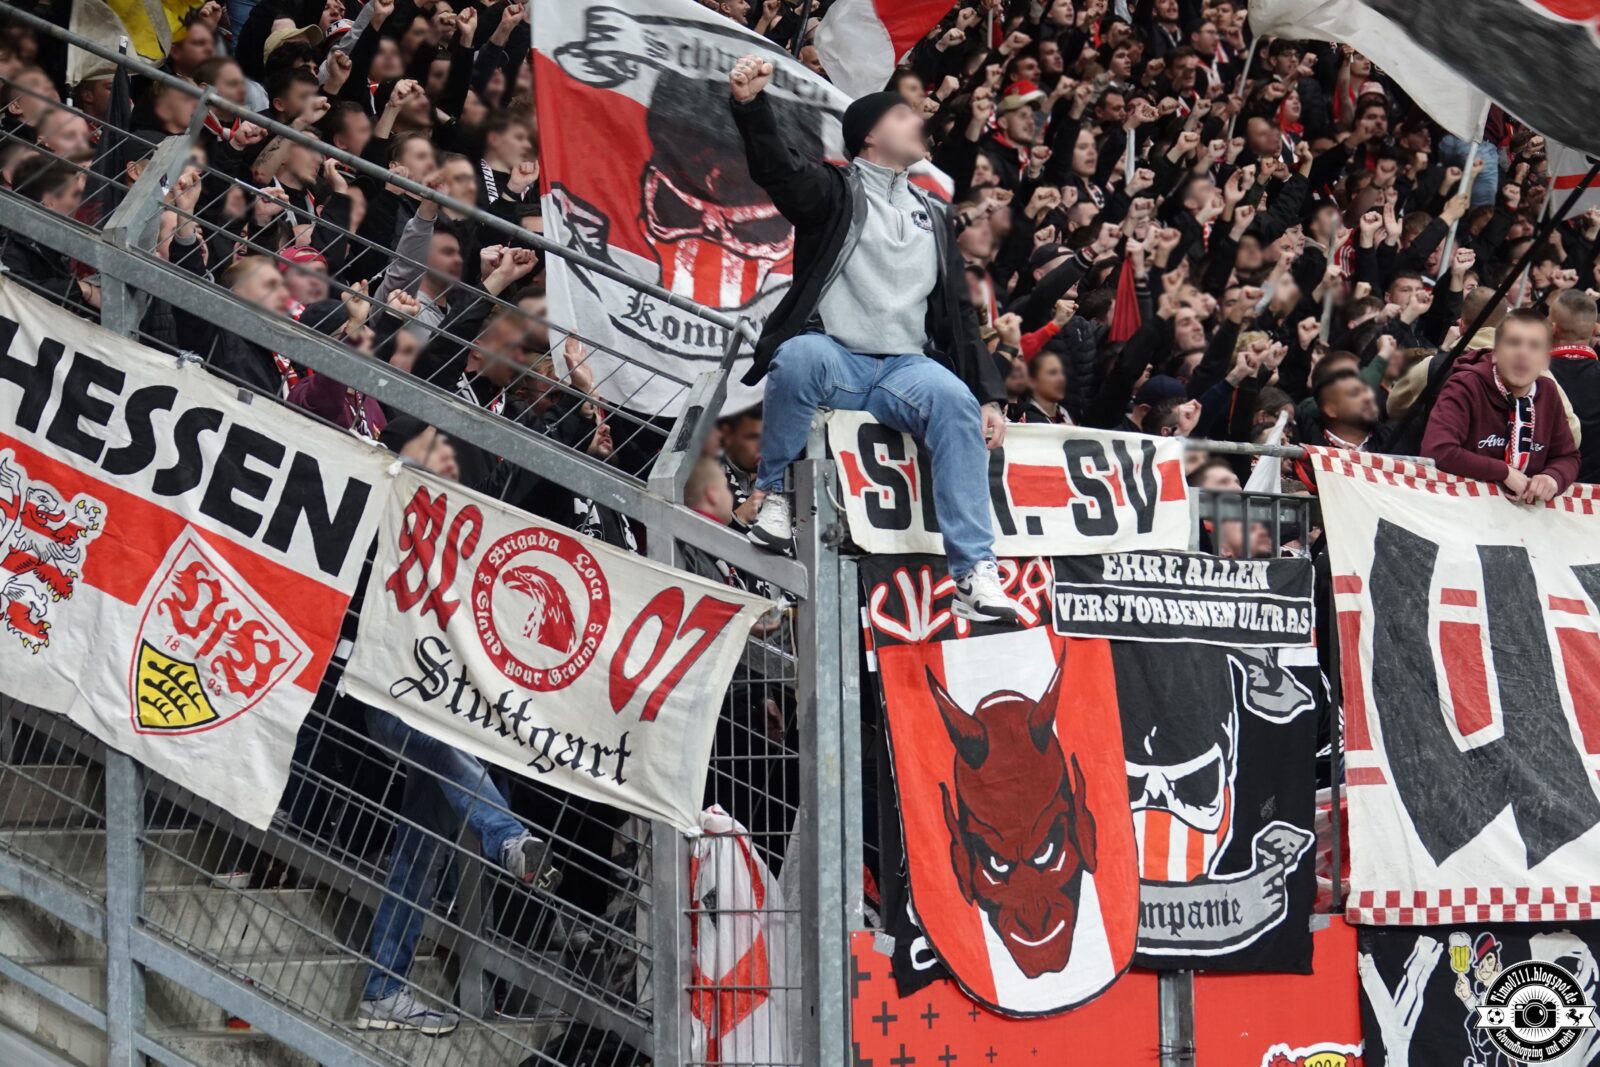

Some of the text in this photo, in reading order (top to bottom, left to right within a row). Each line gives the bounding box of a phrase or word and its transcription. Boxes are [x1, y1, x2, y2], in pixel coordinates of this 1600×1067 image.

[0, 313, 372, 577] HESSEN
[488, 532, 604, 600] Brigada Loca
[1101, 552, 1271, 590] EHRE ALLEN
[164, 634, 180, 651] 18
[476, 590, 502, 656] Stand
[548, 637, 597, 686] Ground
[588, 622, 603, 634] 07
[1056, 592, 1312, 636] VERSTORBENEN ULTRAS
[608, 586, 745, 722] 07
[390, 636, 632, 785] Stuttgart
